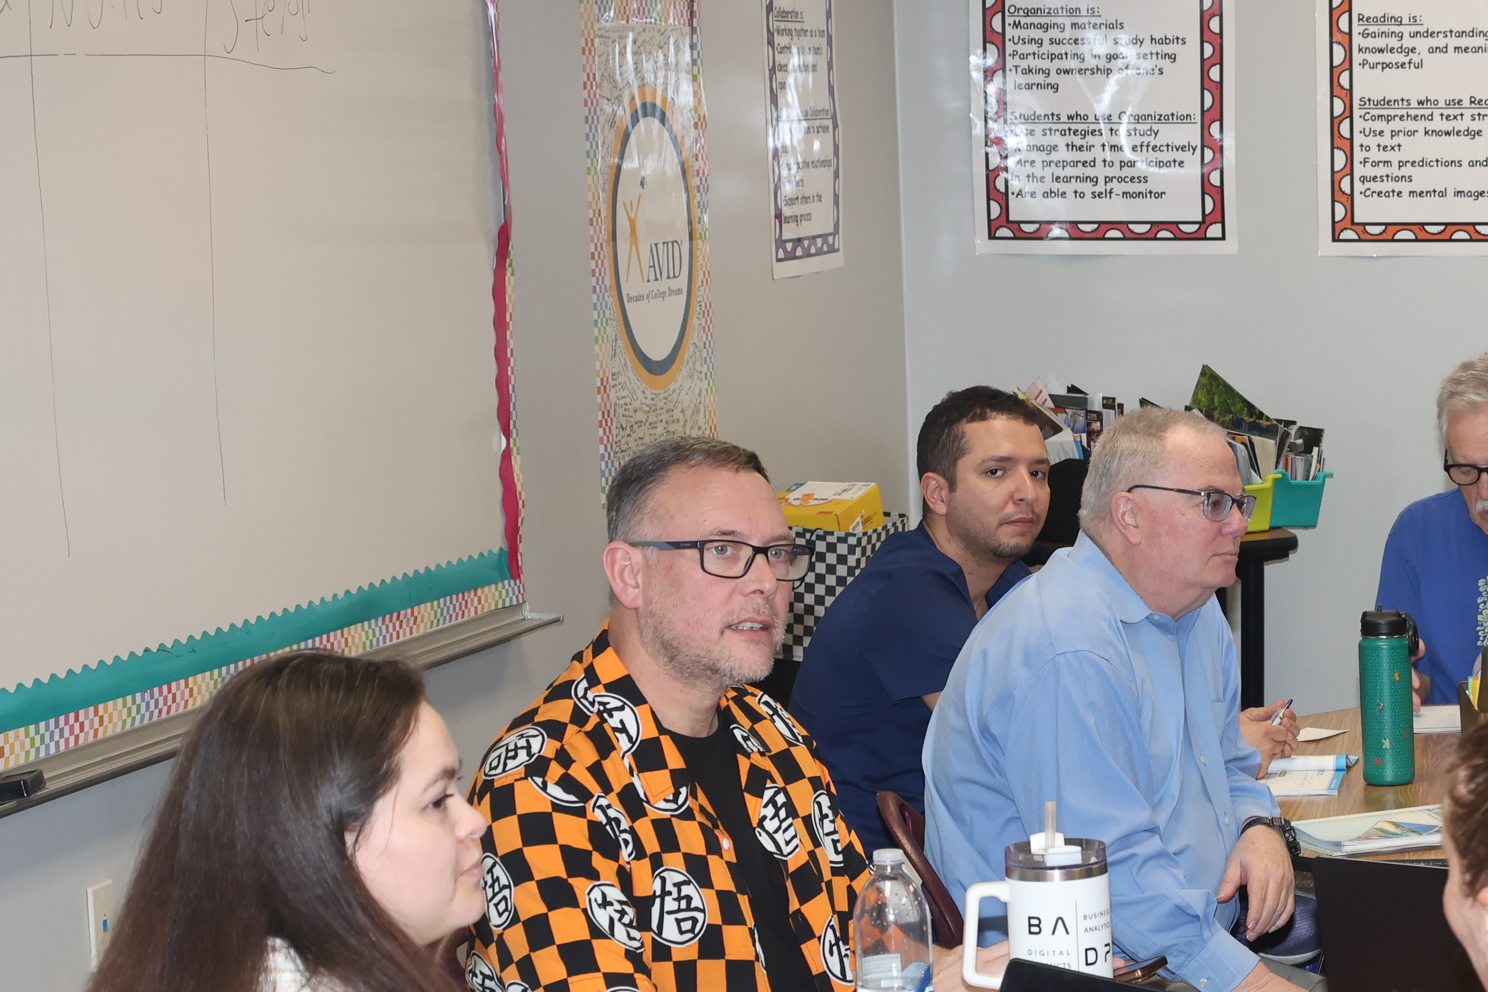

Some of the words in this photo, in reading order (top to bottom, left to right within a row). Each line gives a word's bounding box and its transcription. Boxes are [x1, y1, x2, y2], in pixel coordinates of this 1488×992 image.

[1008, 4, 1082, 16] Organization
[1087, 4, 1100, 15] is:
[1012, 20, 1065, 31] Managing
[1071, 20, 1124, 30] materials
[1358, 14, 1403, 25] Reading
[1409, 14, 1423, 23] is:
[1012, 35, 1043, 47] Using
[1049, 35, 1107, 45] successful
[1151, 35, 1186, 45] habits
[1362, 29, 1403, 41] Gaining
[1012, 50, 1085, 62] Participating
[1136, 50, 1176, 62] setting
[1358, 44, 1421, 56] knowledge,
[1428, 44, 1448, 54] and
[1012, 65, 1050, 77] Taking
[1056, 66, 1112, 77] ownership
[1118, 66, 1130, 75] of
[1362, 60, 1423, 72] Purposeful
[1014, 81, 1059, 93] learning
[1359, 97, 1411, 107] Students
[1417, 97, 1439, 106] who
[1445, 98, 1464, 106] use
[1010, 112, 1061, 122] Students
[1067, 112, 1089, 121] who
[1118, 112, 1196, 124] Organization:
[1363, 112, 1433, 124] Comprehend
[1439, 112, 1465, 121] text
[1042, 127, 1103, 139] strategies
[1126, 127, 1159, 139] study
[1363, 127, 1384, 137] Use
[1390, 128, 1418, 140] prior
[1424, 127, 1482, 140] knowledge
[1065, 142, 1095, 152] their
[1101, 143, 1125, 152] time
[1132, 142, 1198, 155] effectively
[1359, 143, 1371, 152] to
[1377, 143, 1402, 152] text
[1042, 158, 1096, 171] prepared
[1102, 158, 1114, 168] to
[1120, 158, 1184, 171] participate
[1363, 158, 1392, 168] Form
[1398, 157, 1462, 170] predictions
[1468, 158, 1488, 167] and
[1026, 174, 1046, 183] the
[1051, 174, 1098, 186] learning
[1104, 175, 1148, 186] process
[1359, 173, 1413, 185] questions
[1016, 189, 1036, 199] Are
[1043, 189, 1067, 199] able
[1073, 189, 1085, 199] to
[1091, 189, 1166, 199] self-monitor
[1363, 188, 1403, 198] Create
[1409, 188, 1447, 198] mental
[647, 240, 681, 282] AVID
[627, 292, 645, 303] Decades
[651, 289, 666, 301] College
[668, 287, 683, 297] Dreams
